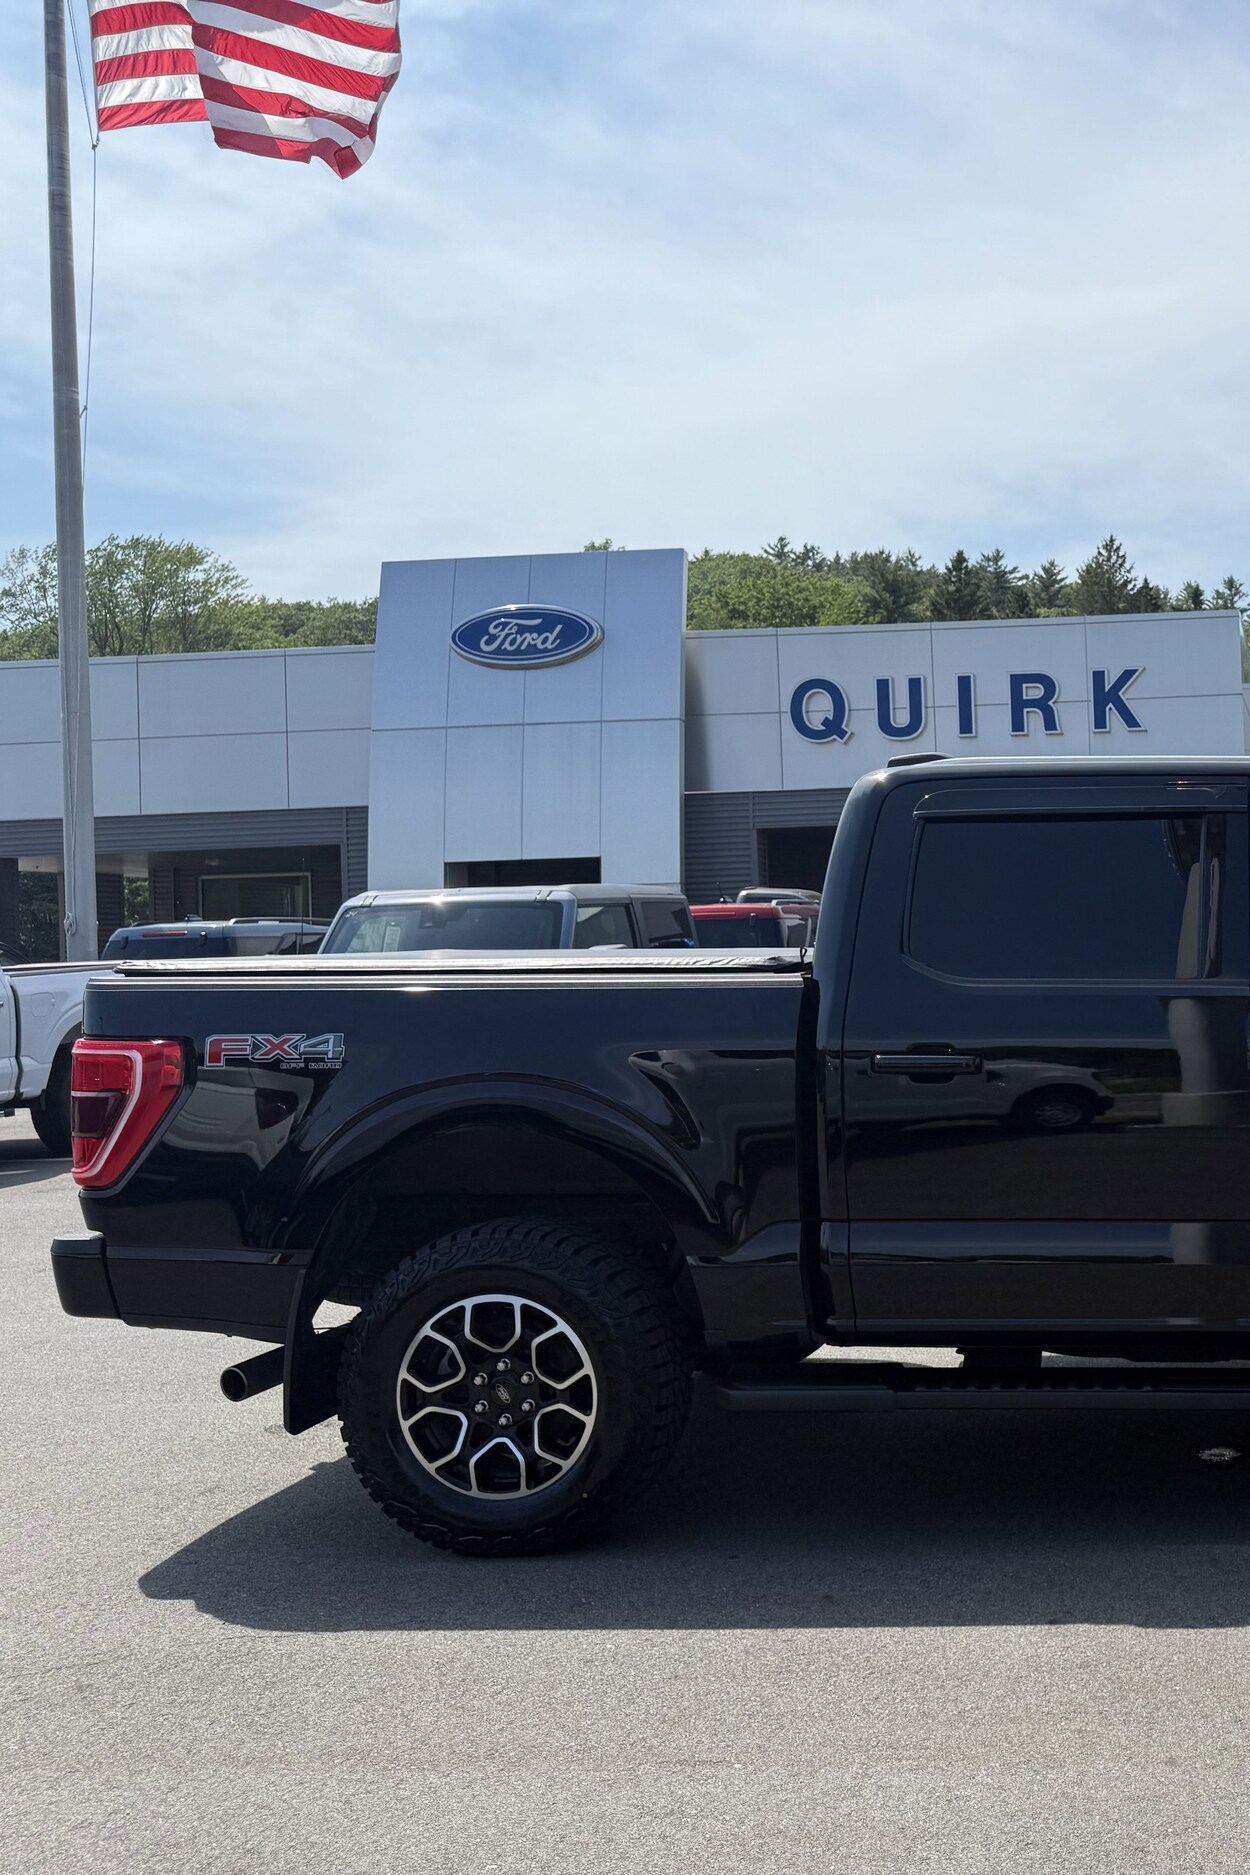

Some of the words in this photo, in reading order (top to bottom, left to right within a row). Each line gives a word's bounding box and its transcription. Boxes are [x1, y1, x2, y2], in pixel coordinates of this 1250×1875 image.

[479, 618, 563, 652] Ford
[789, 667, 1147, 744] QUIRK
[204, 1033, 345, 1069] FX4
